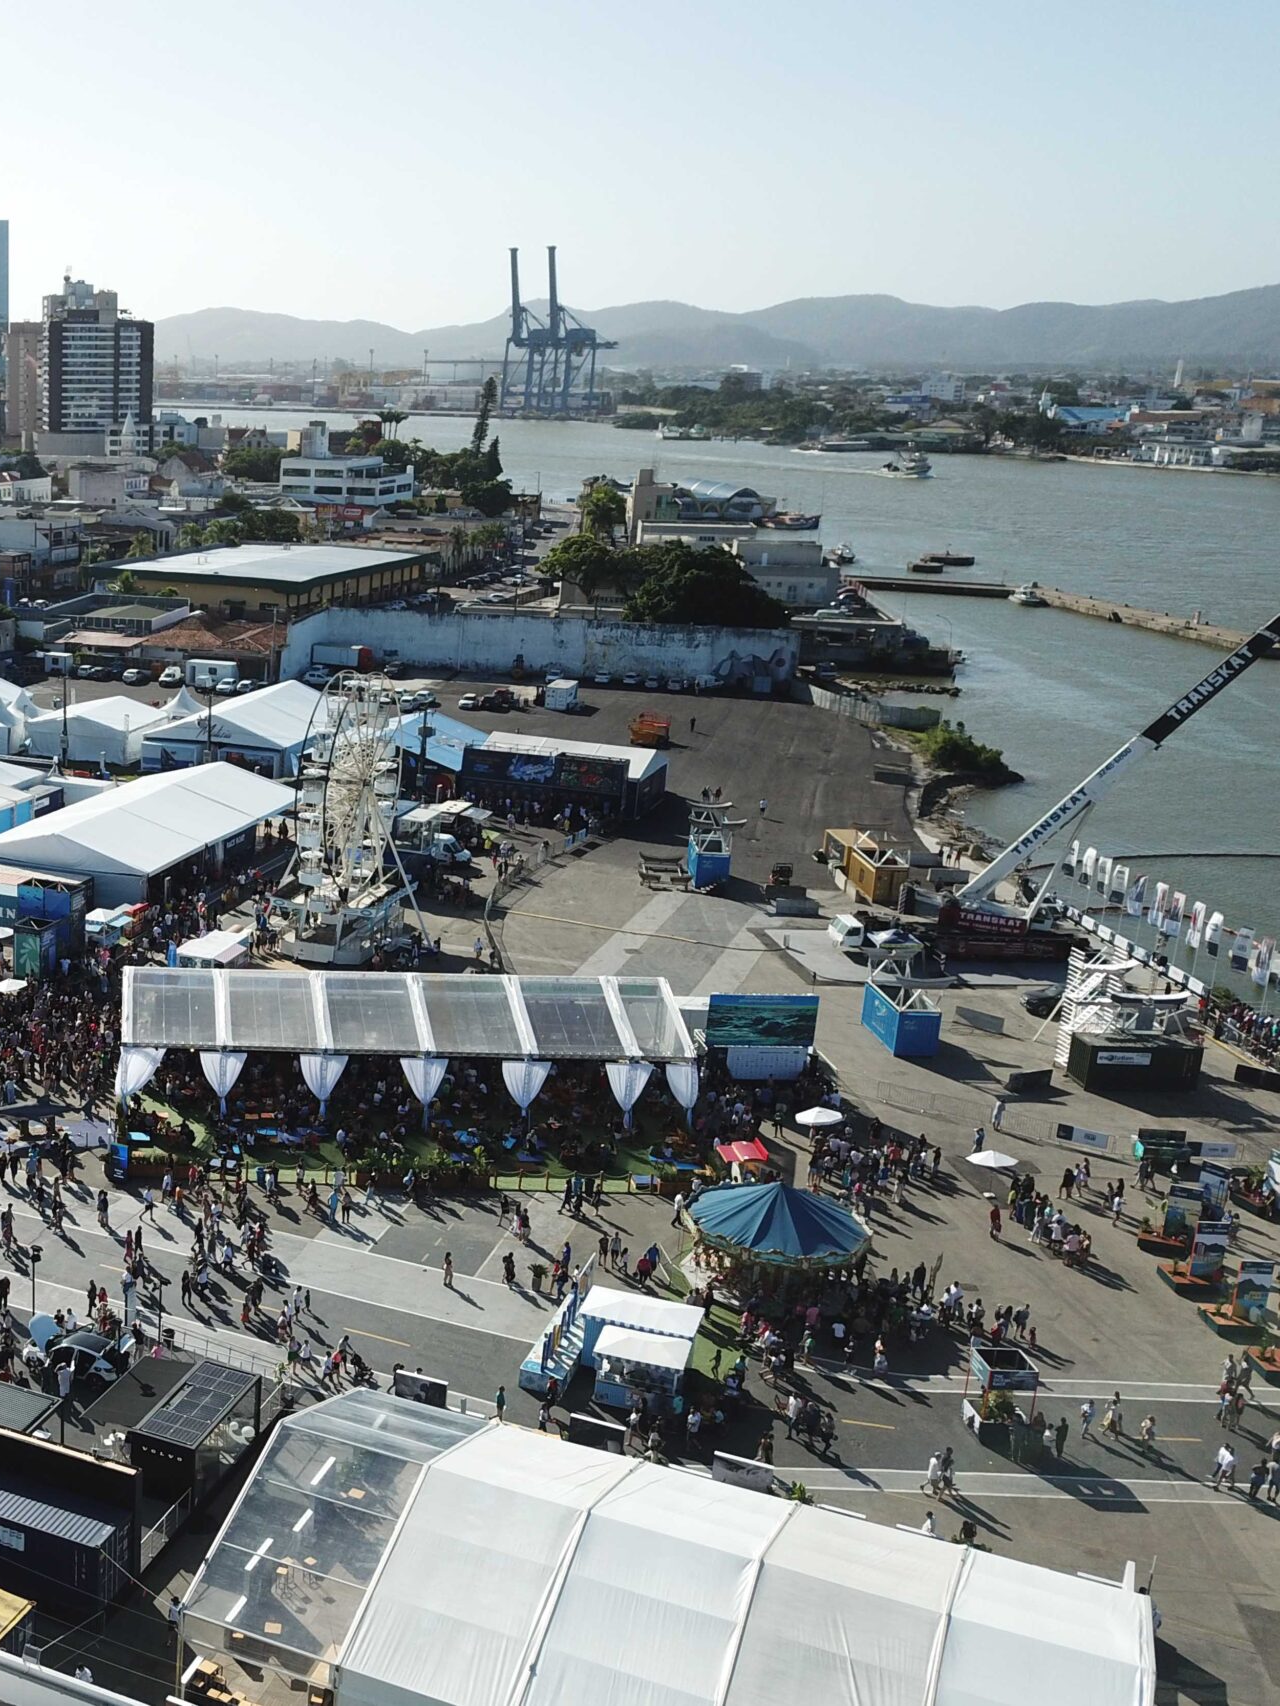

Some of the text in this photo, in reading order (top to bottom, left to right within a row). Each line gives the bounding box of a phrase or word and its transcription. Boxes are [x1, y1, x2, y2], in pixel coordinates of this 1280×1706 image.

[1166, 645, 1254, 720] TRANSKAT
[1011, 787, 1087, 855] TRANSKAT
[960, 911, 1022, 927] TRANSKAT
[141, 1446, 183, 1461] VOLVO
